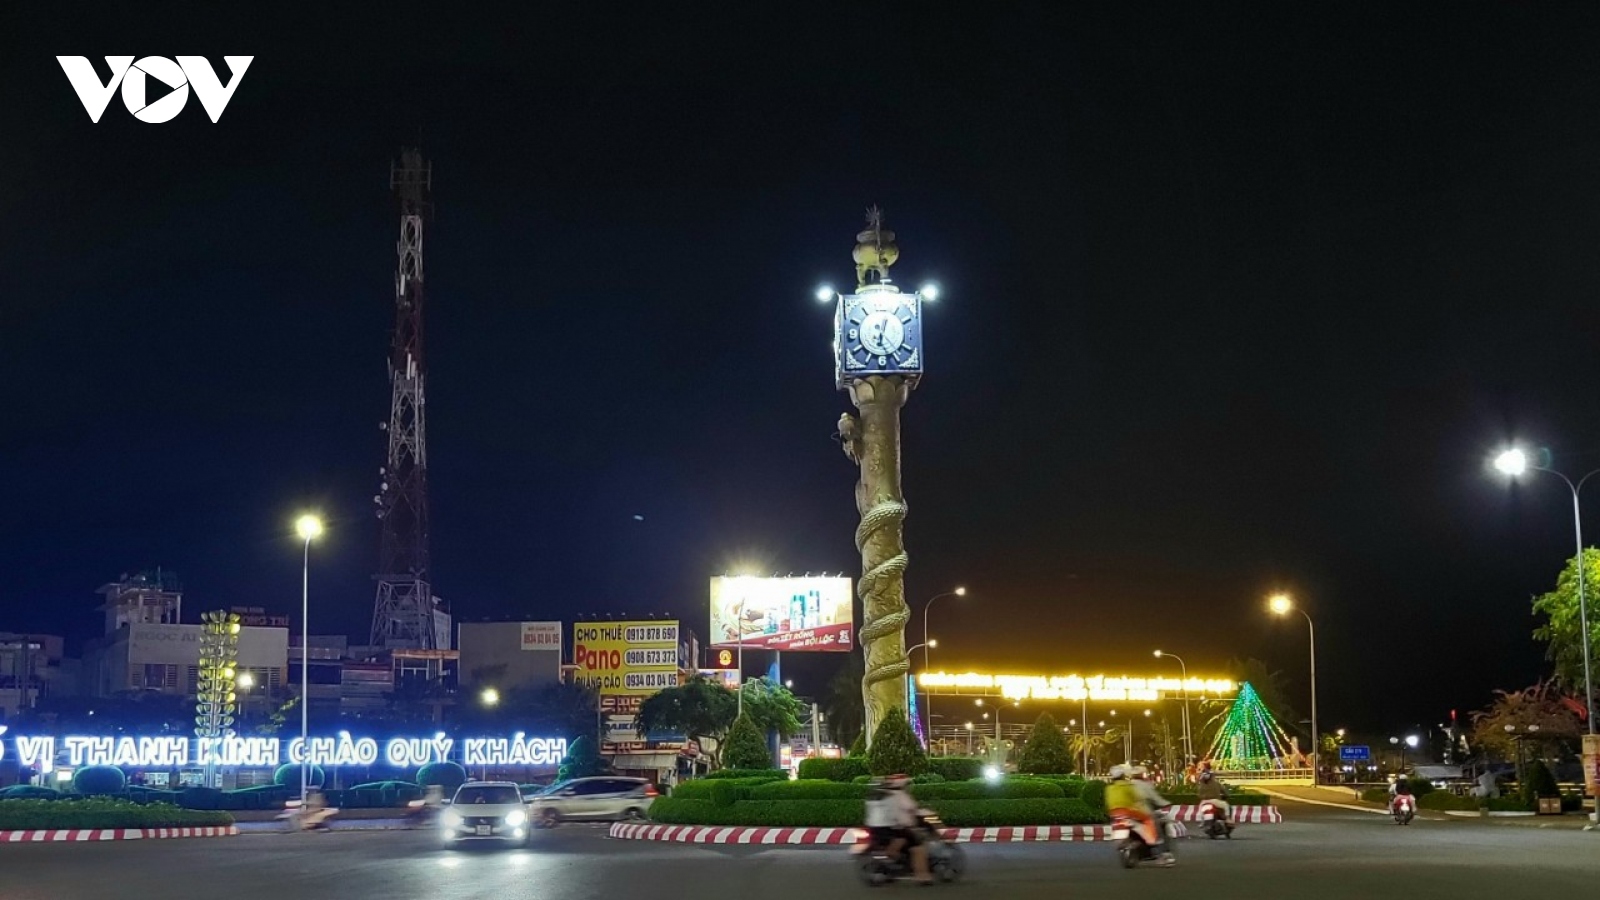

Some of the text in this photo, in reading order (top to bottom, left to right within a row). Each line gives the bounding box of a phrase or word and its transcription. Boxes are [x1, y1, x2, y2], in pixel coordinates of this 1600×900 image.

[848, 329, 858, 339] 9
[878, 356, 887, 366] 6
[576, 624, 622, 641] CHO THUÊ
[626, 627, 676, 641] 0913 878 690
[575, 644, 621, 670] Pano
[626, 650, 676, 663] 0908 673 373
[603, 673, 621, 689] CÁO
[626, 673, 677, 687] 0934 03 04 05
[16, 736, 54, 773] VỊ
[65, 736, 188, 766] THANH
[197, 730, 280, 766] KÍNH
[288, 730, 378, 766] CHÀO
[387, 731, 454, 767] QUÝ
[464, 732, 567, 765] KHÁCH
